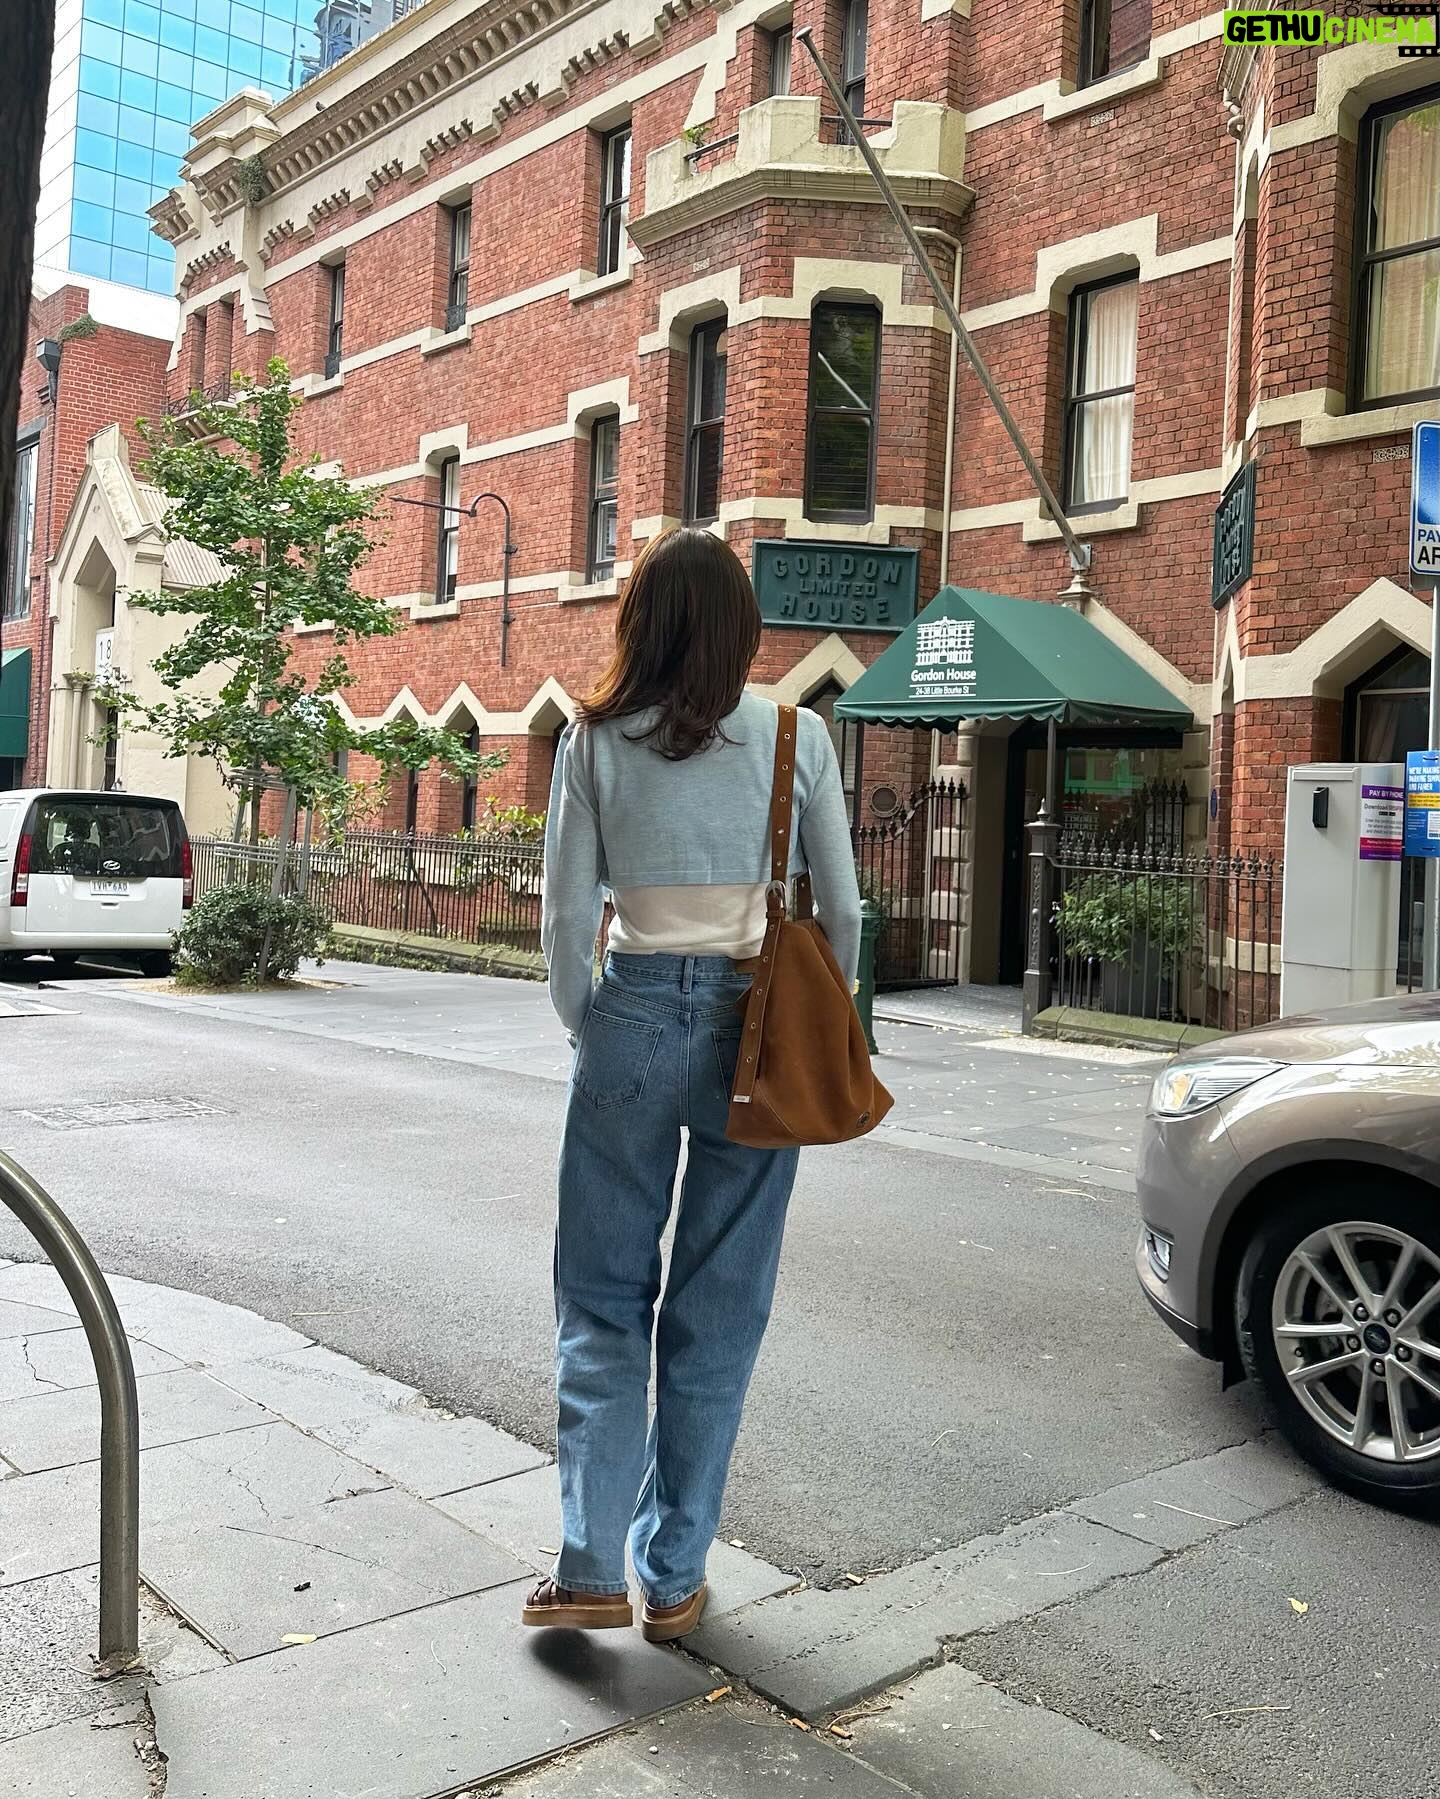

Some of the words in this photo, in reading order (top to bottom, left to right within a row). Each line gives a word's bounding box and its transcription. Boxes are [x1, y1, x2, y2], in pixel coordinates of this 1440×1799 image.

[773, 552, 901, 584] GORDON
[799, 578, 877, 597] LIMITED
[779, 592, 889, 622] HOUSE
[100, 639, 111, 660] 18
[911, 668, 945, 681] Gordon
[946, 668, 976, 680] House
[916, 687, 930, 696] 24-38
[931, 686, 943, 695] Little
[944, 686, 962, 694] Bourke
[963, 685, 970, 694] St
